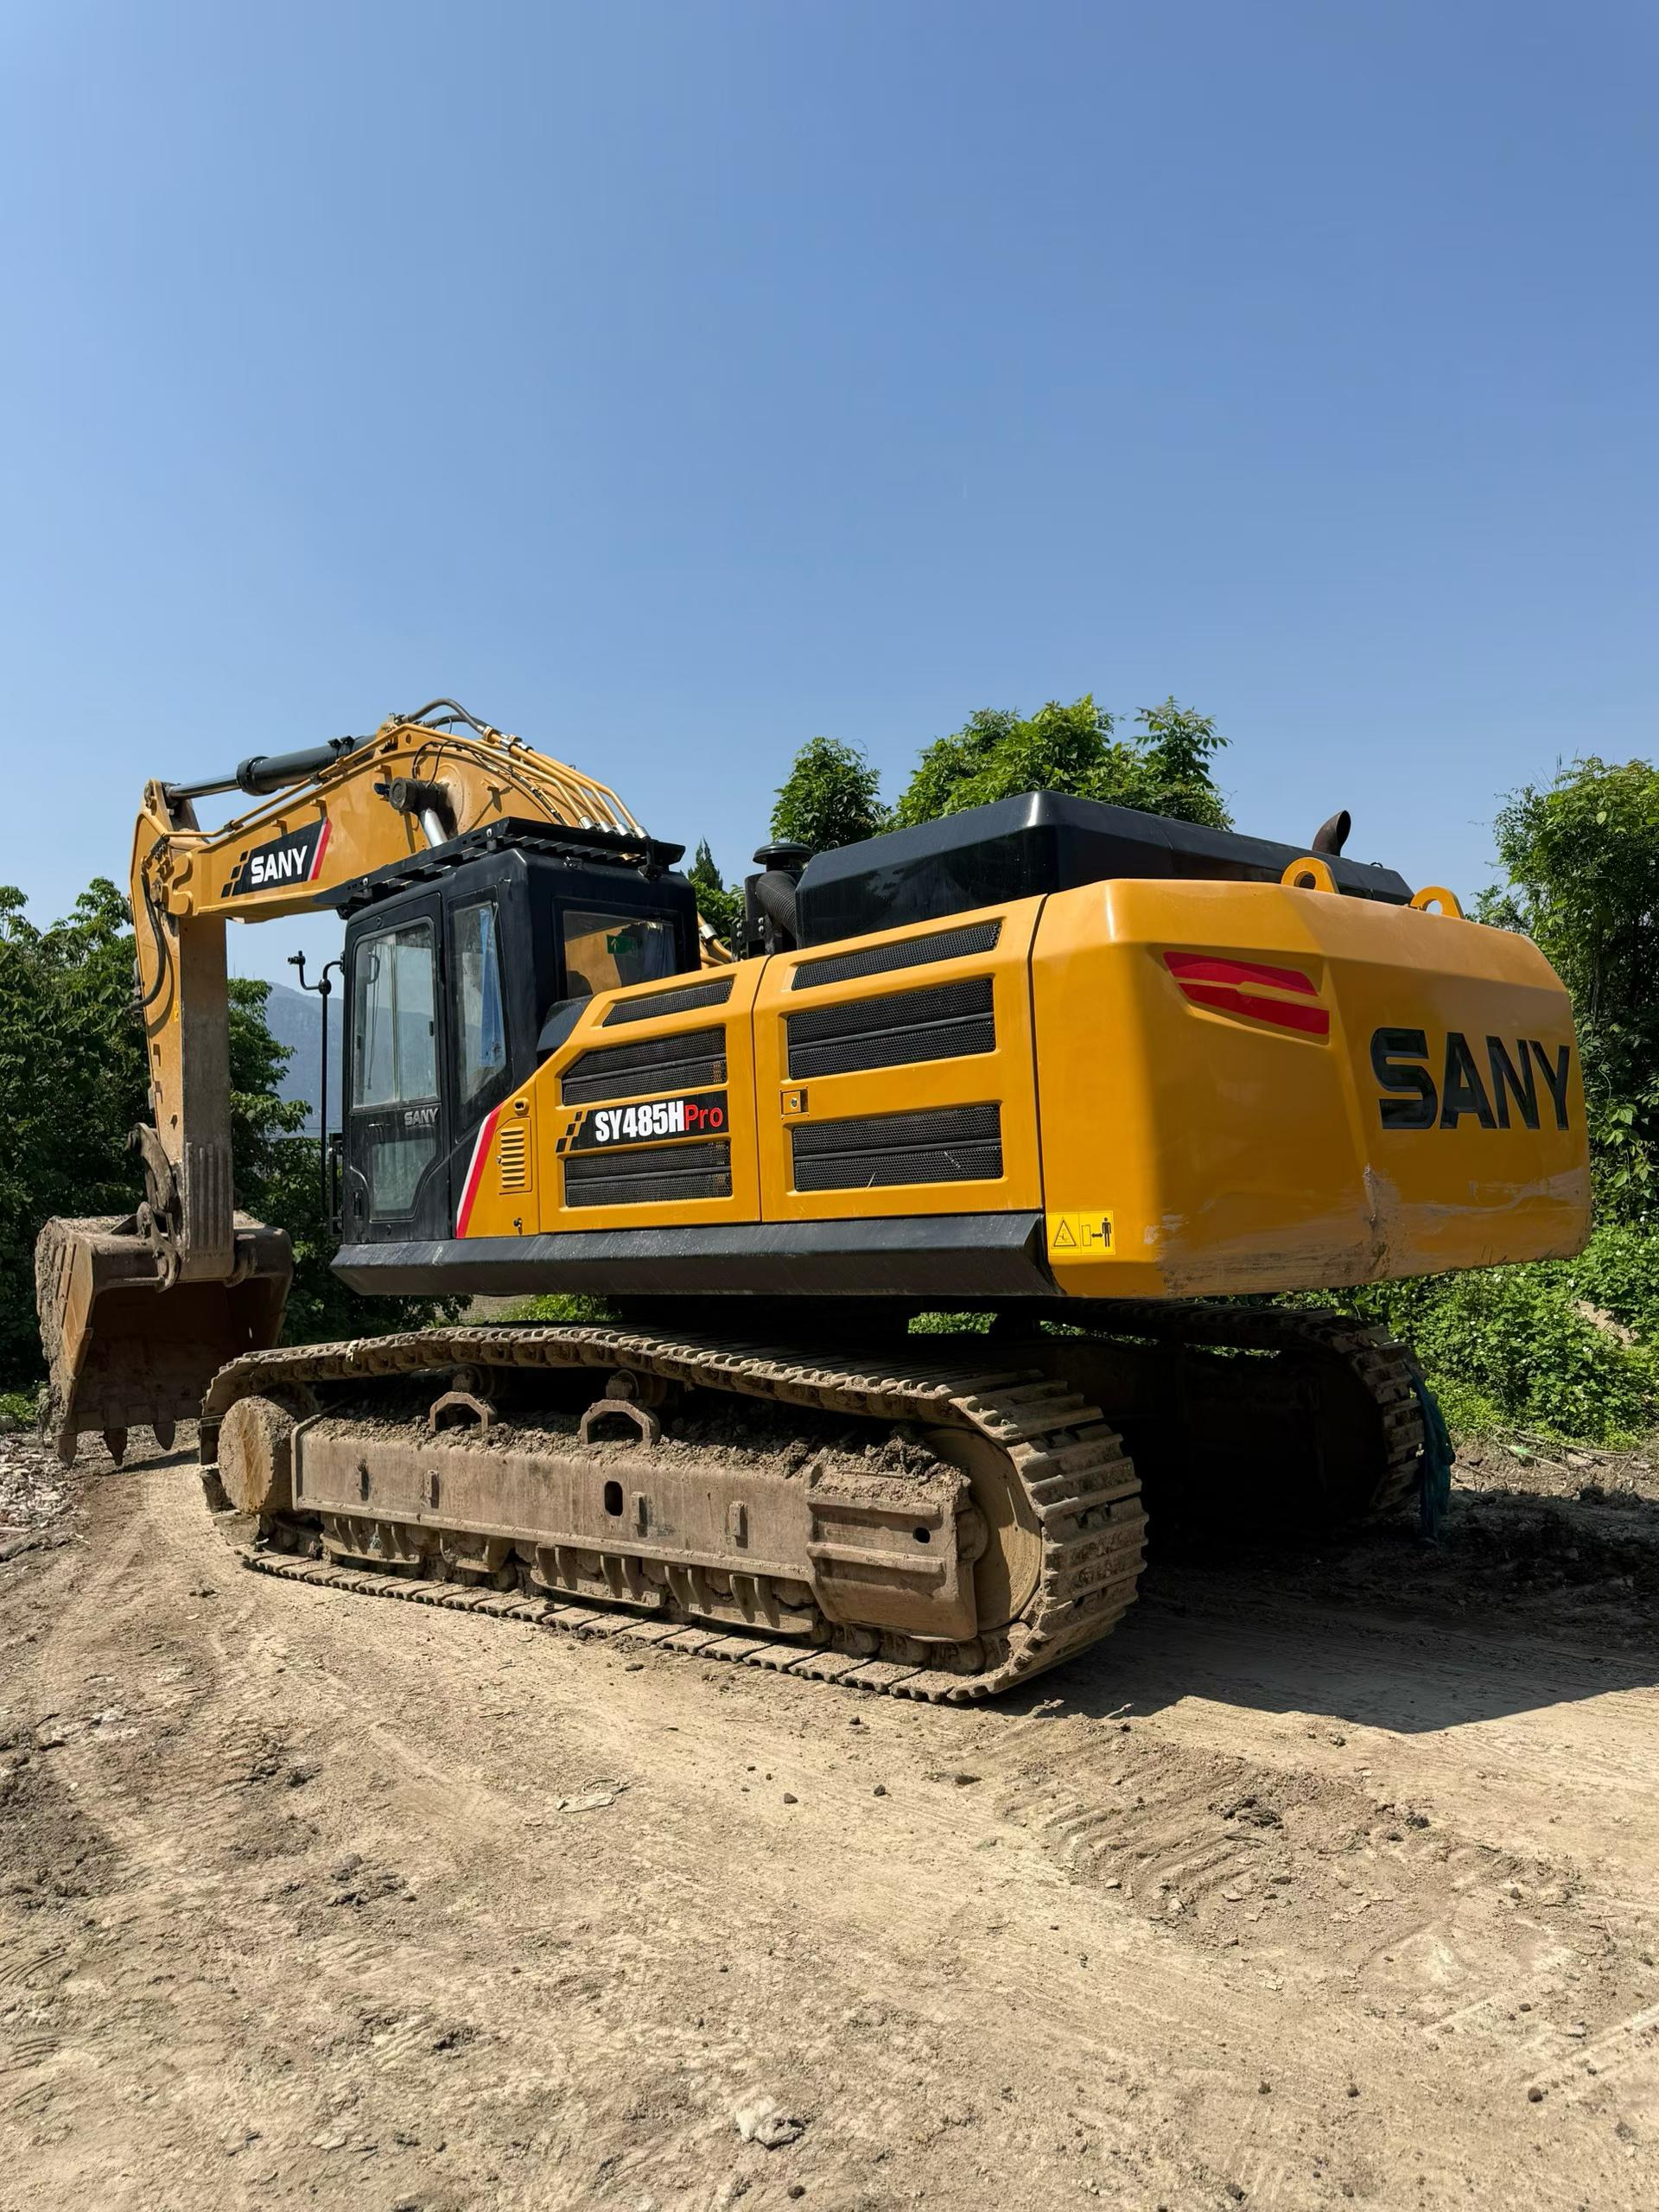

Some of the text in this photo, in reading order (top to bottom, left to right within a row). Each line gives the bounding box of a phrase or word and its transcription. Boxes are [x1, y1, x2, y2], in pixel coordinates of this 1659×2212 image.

[251, 845, 308, 884] SANY
[1370, 1027, 1570, 1131] SANY
[404, 1107, 438, 1126] SANY
